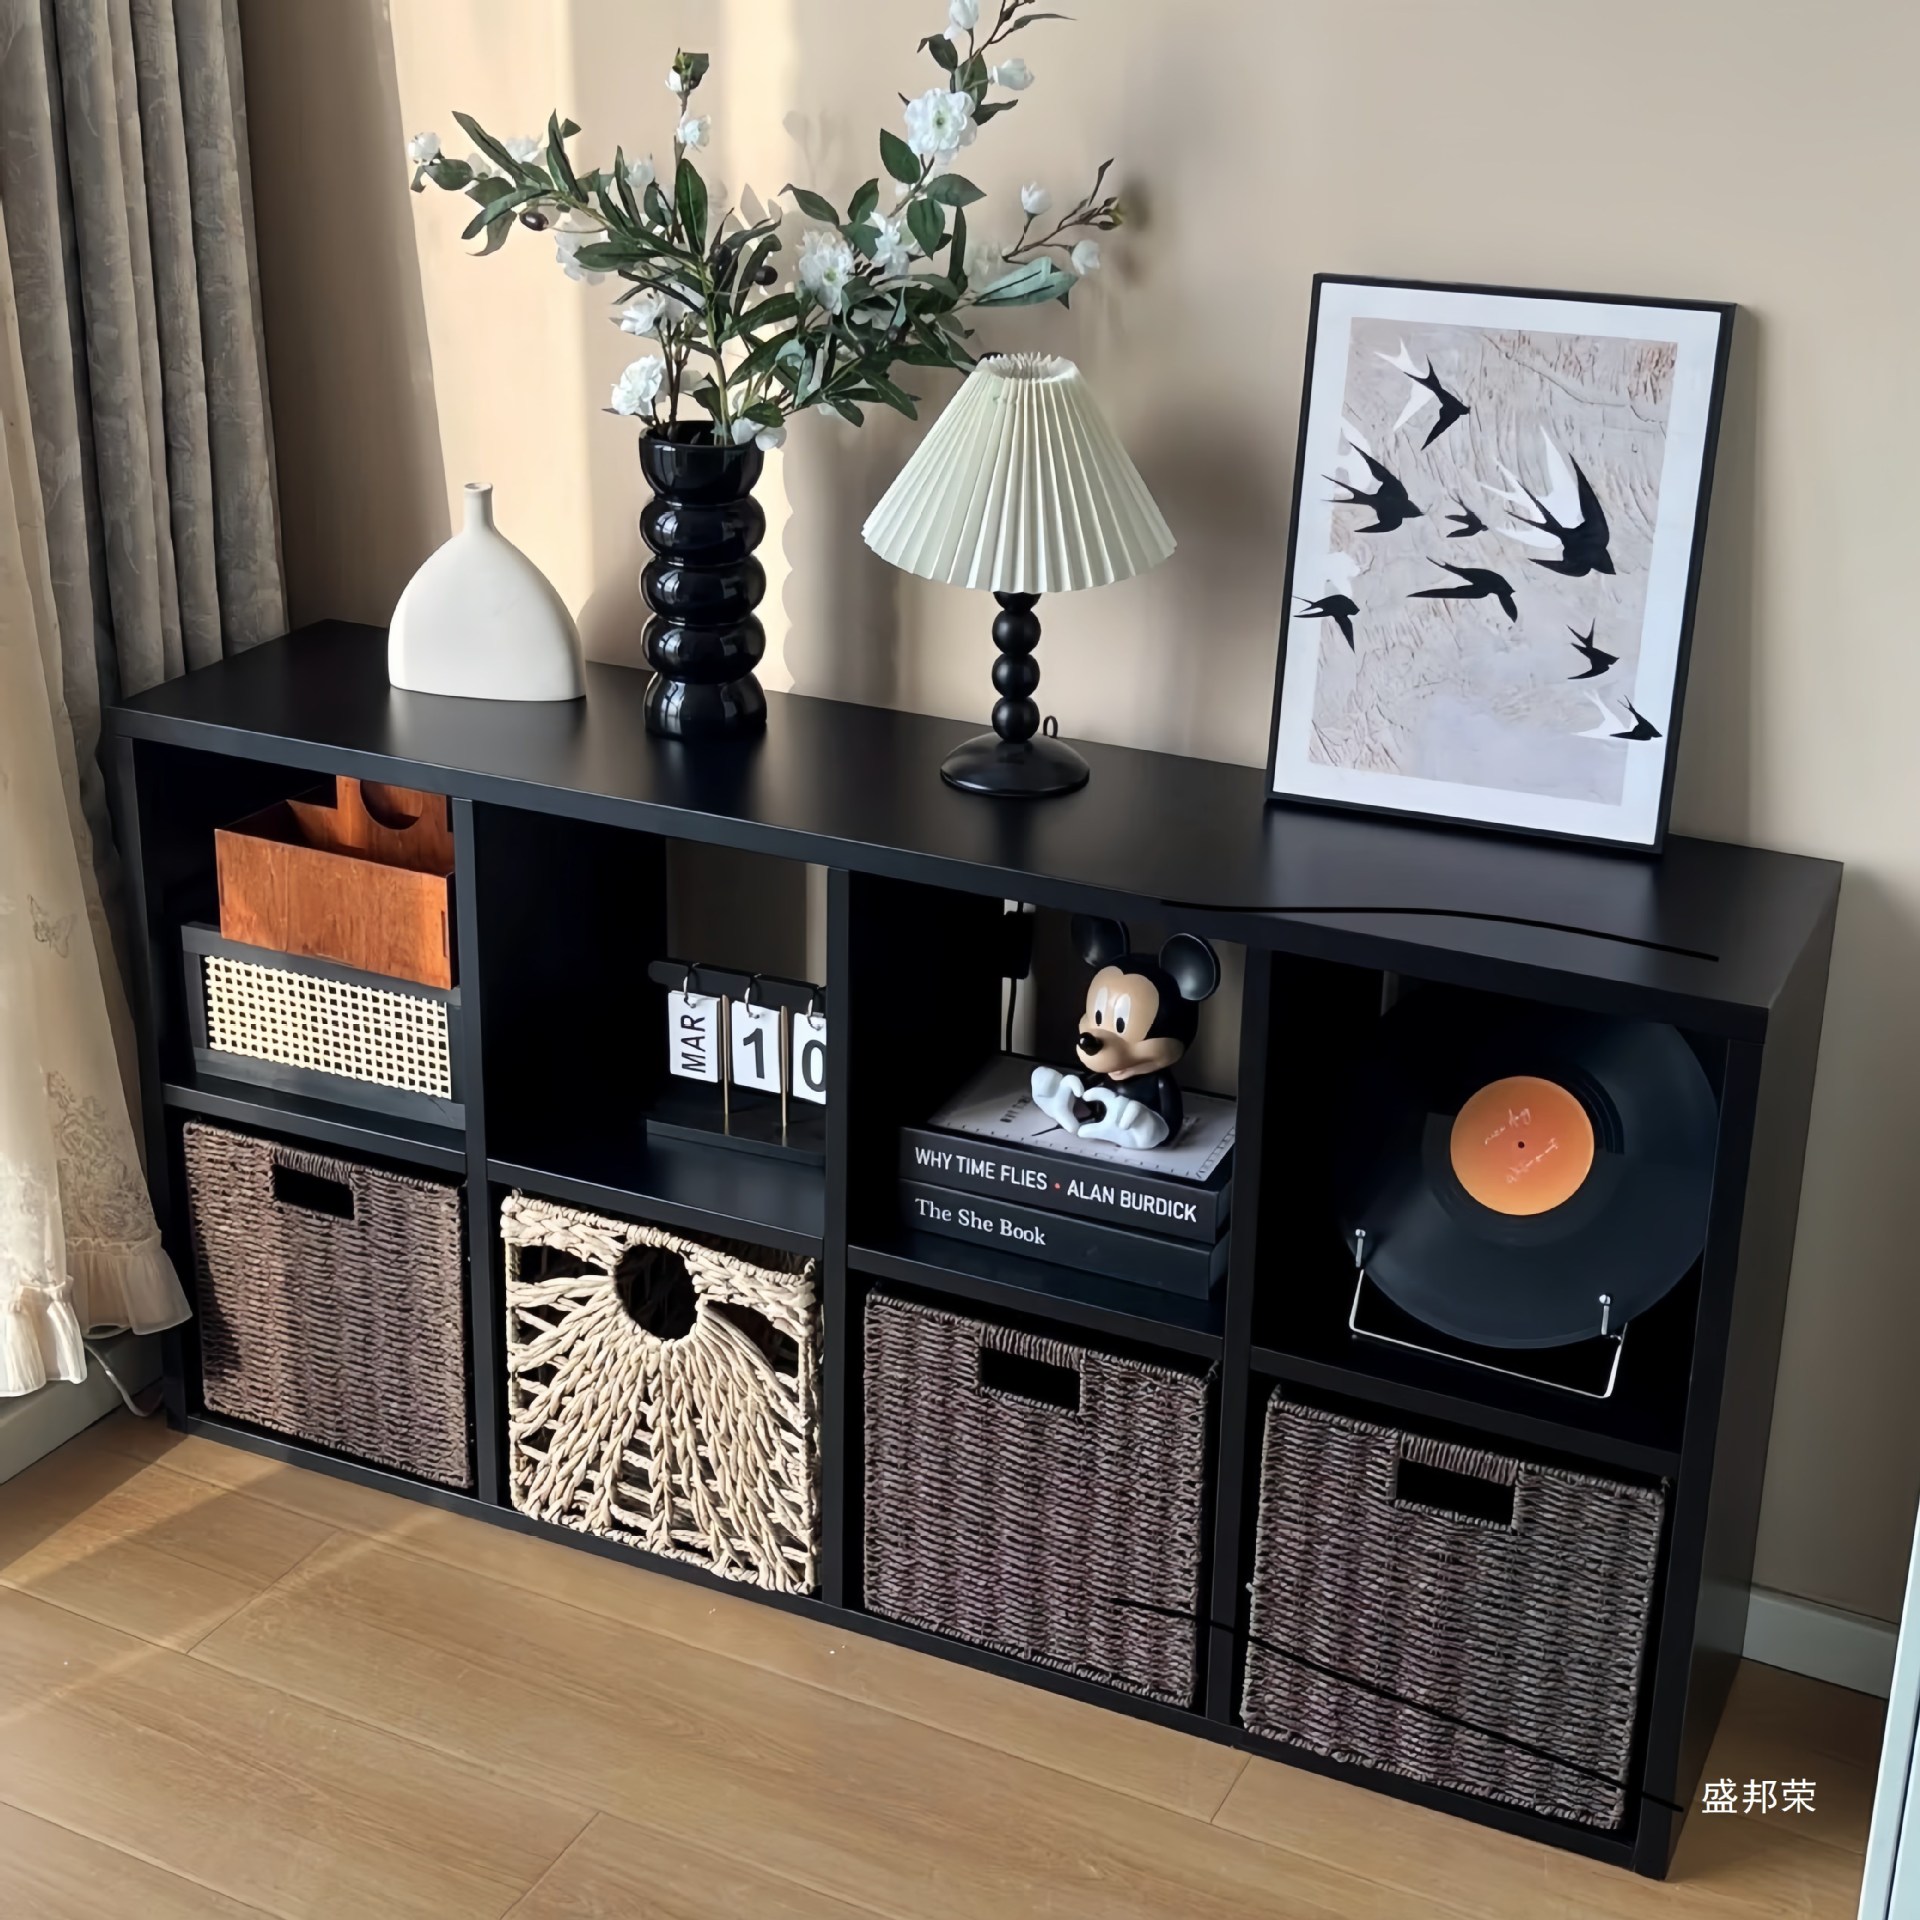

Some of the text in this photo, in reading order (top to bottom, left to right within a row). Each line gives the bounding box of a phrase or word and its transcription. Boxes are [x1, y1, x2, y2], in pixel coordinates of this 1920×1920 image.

[680, 1014, 706, 1074] MAR
[915, 1146, 1197, 1223] WHY TIME FLIES ALAN BURDICK
[915, 1198, 1046, 1246] The She Book
